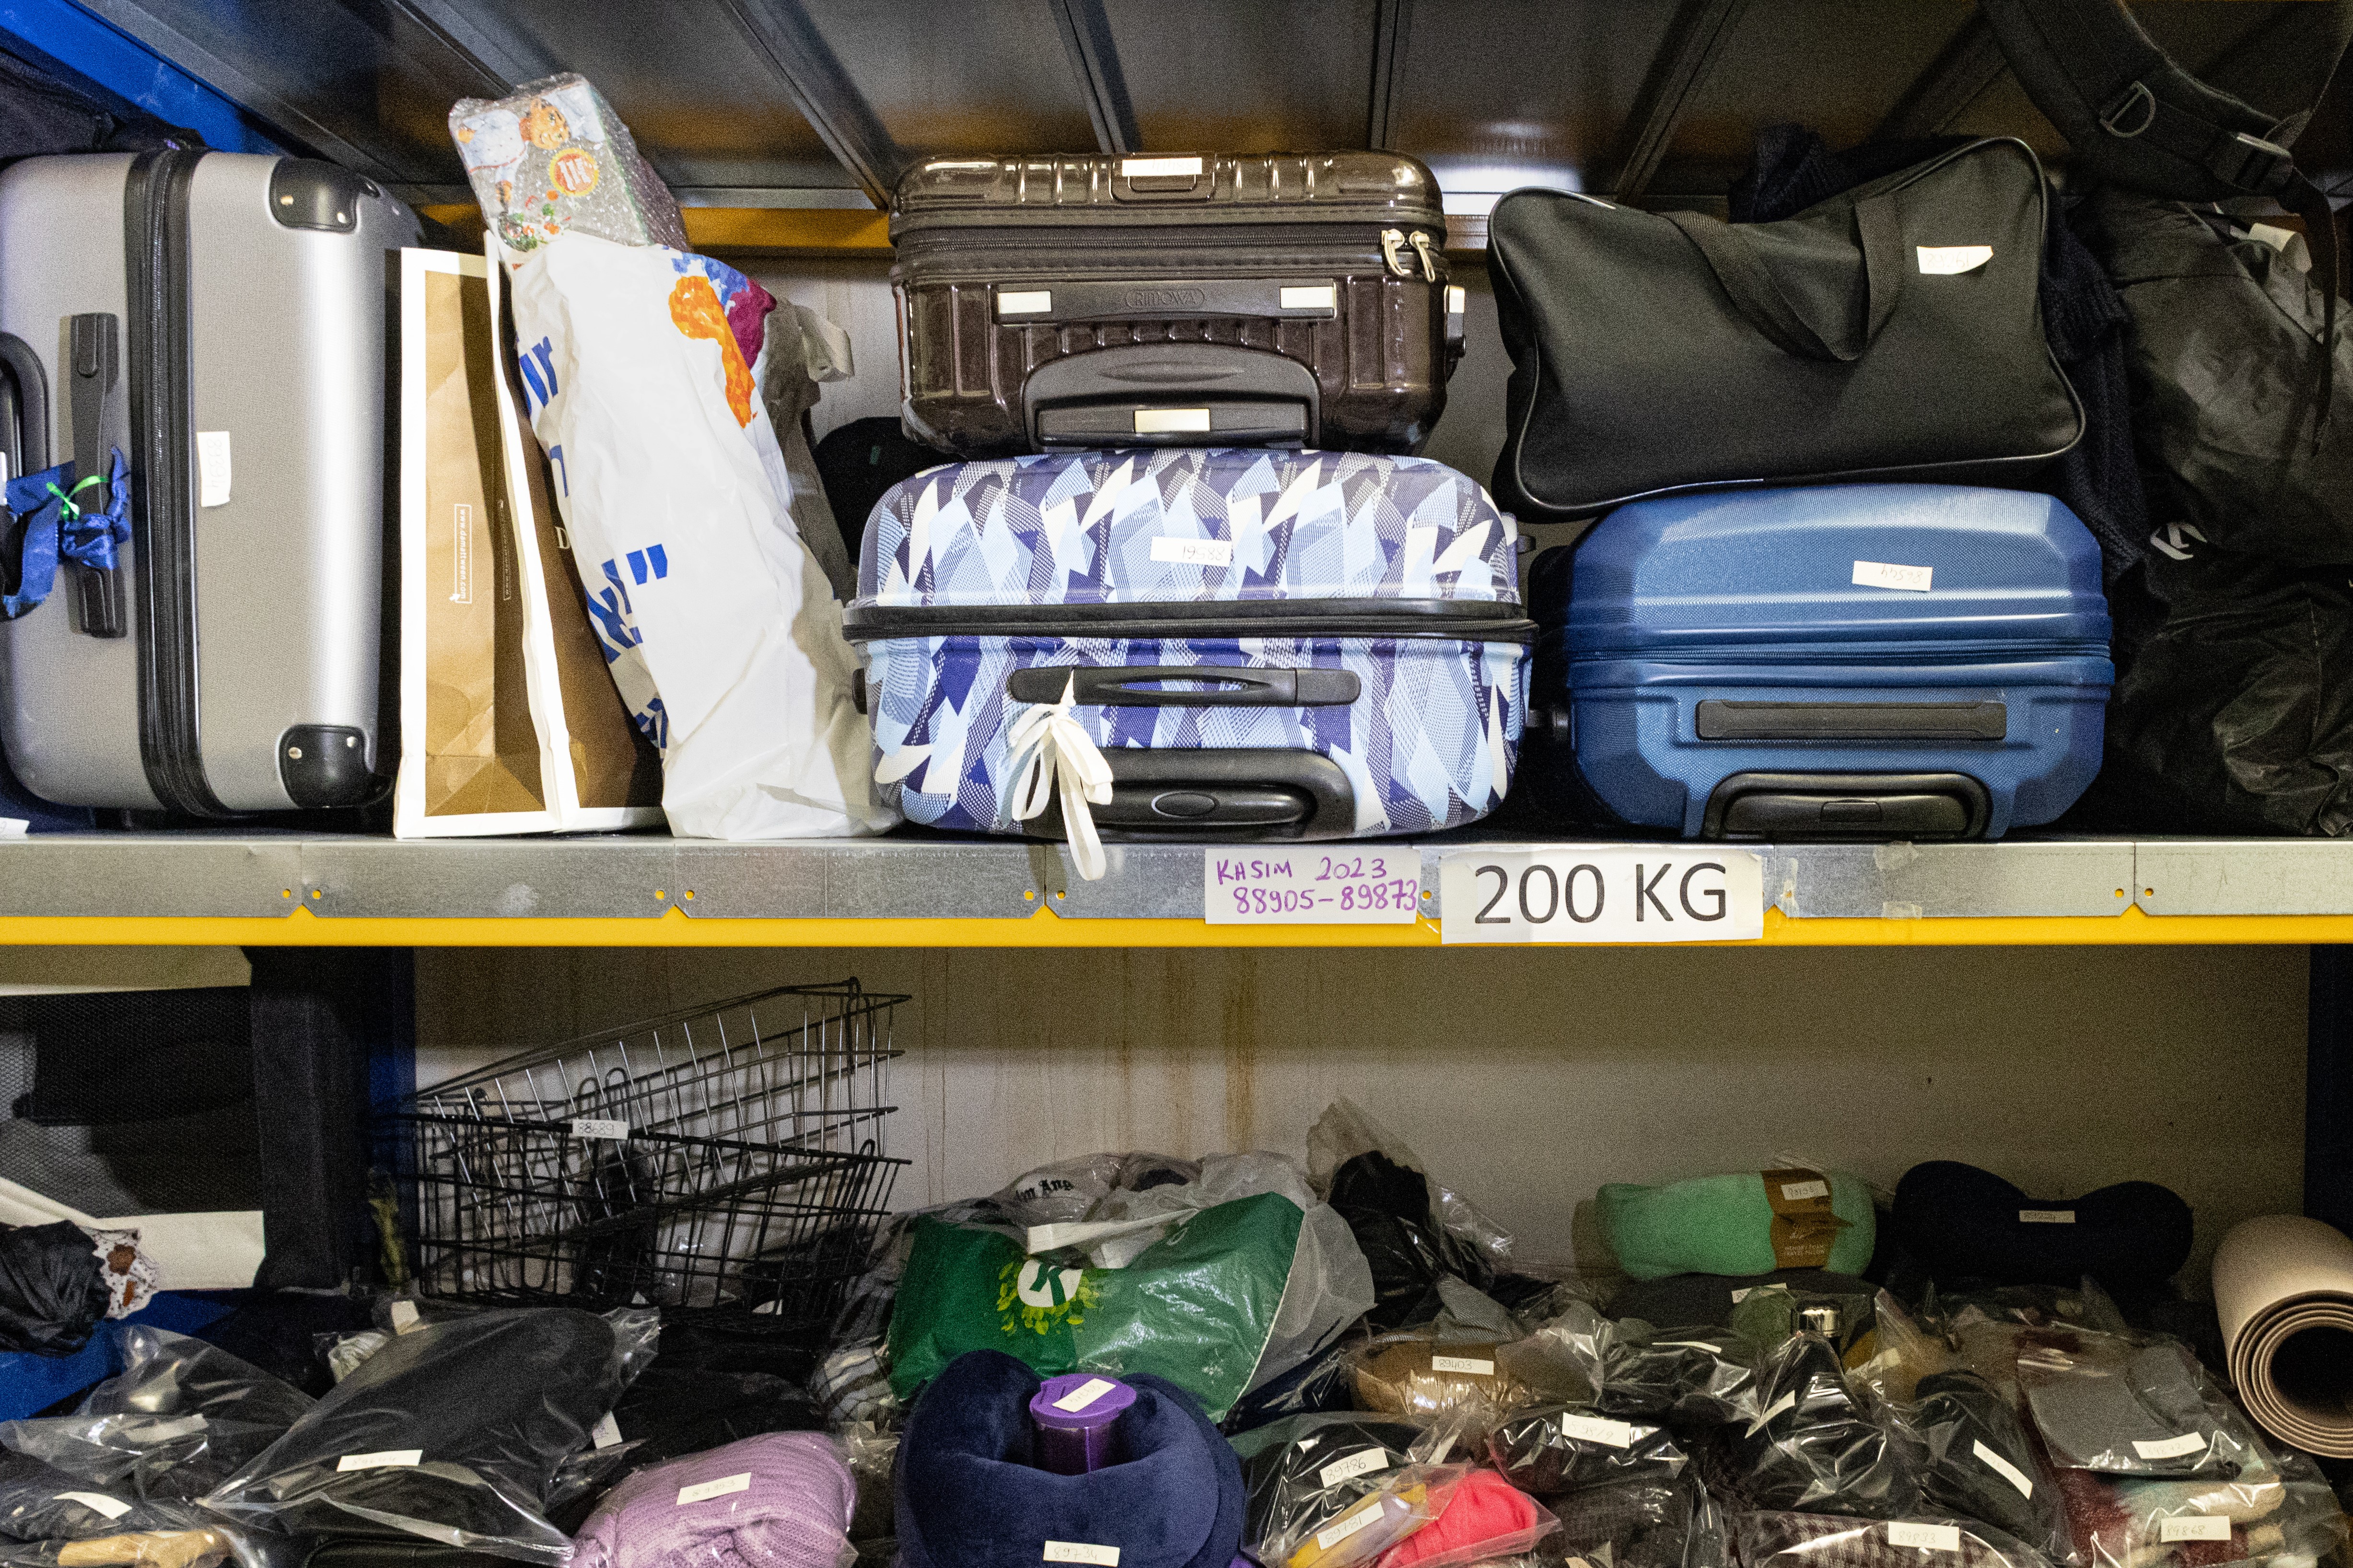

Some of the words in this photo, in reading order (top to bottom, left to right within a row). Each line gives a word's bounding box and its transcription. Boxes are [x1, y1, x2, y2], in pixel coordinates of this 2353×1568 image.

[1925, 251, 1969, 268] 89261
[1134, 291, 1197, 306] RIMOWA
[204, 438, 227, 488] 89394
[1182, 545, 1226, 561] 88561
[1216, 859, 1293, 885] KASIM
[1315, 856, 1387, 882] 2023
[1474, 863, 1605, 924] 200
[1635, 862, 1726, 922] KG
[577, 1122, 615, 1136] 88689
[1438, 1359, 1473, 1370] 89403
[1568, 1420, 1614, 1441] 89819
[2145, 1442, 2186, 1455] 89873
[1326, 1456, 1367, 1482] 89786
[1325, 1515, 1363, 1544] 89781
[1898, 1530, 1936, 1544] 89833
[2167, 1524, 2206, 1536] 89868
[1053, 1545, 1098, 1561] 89734
